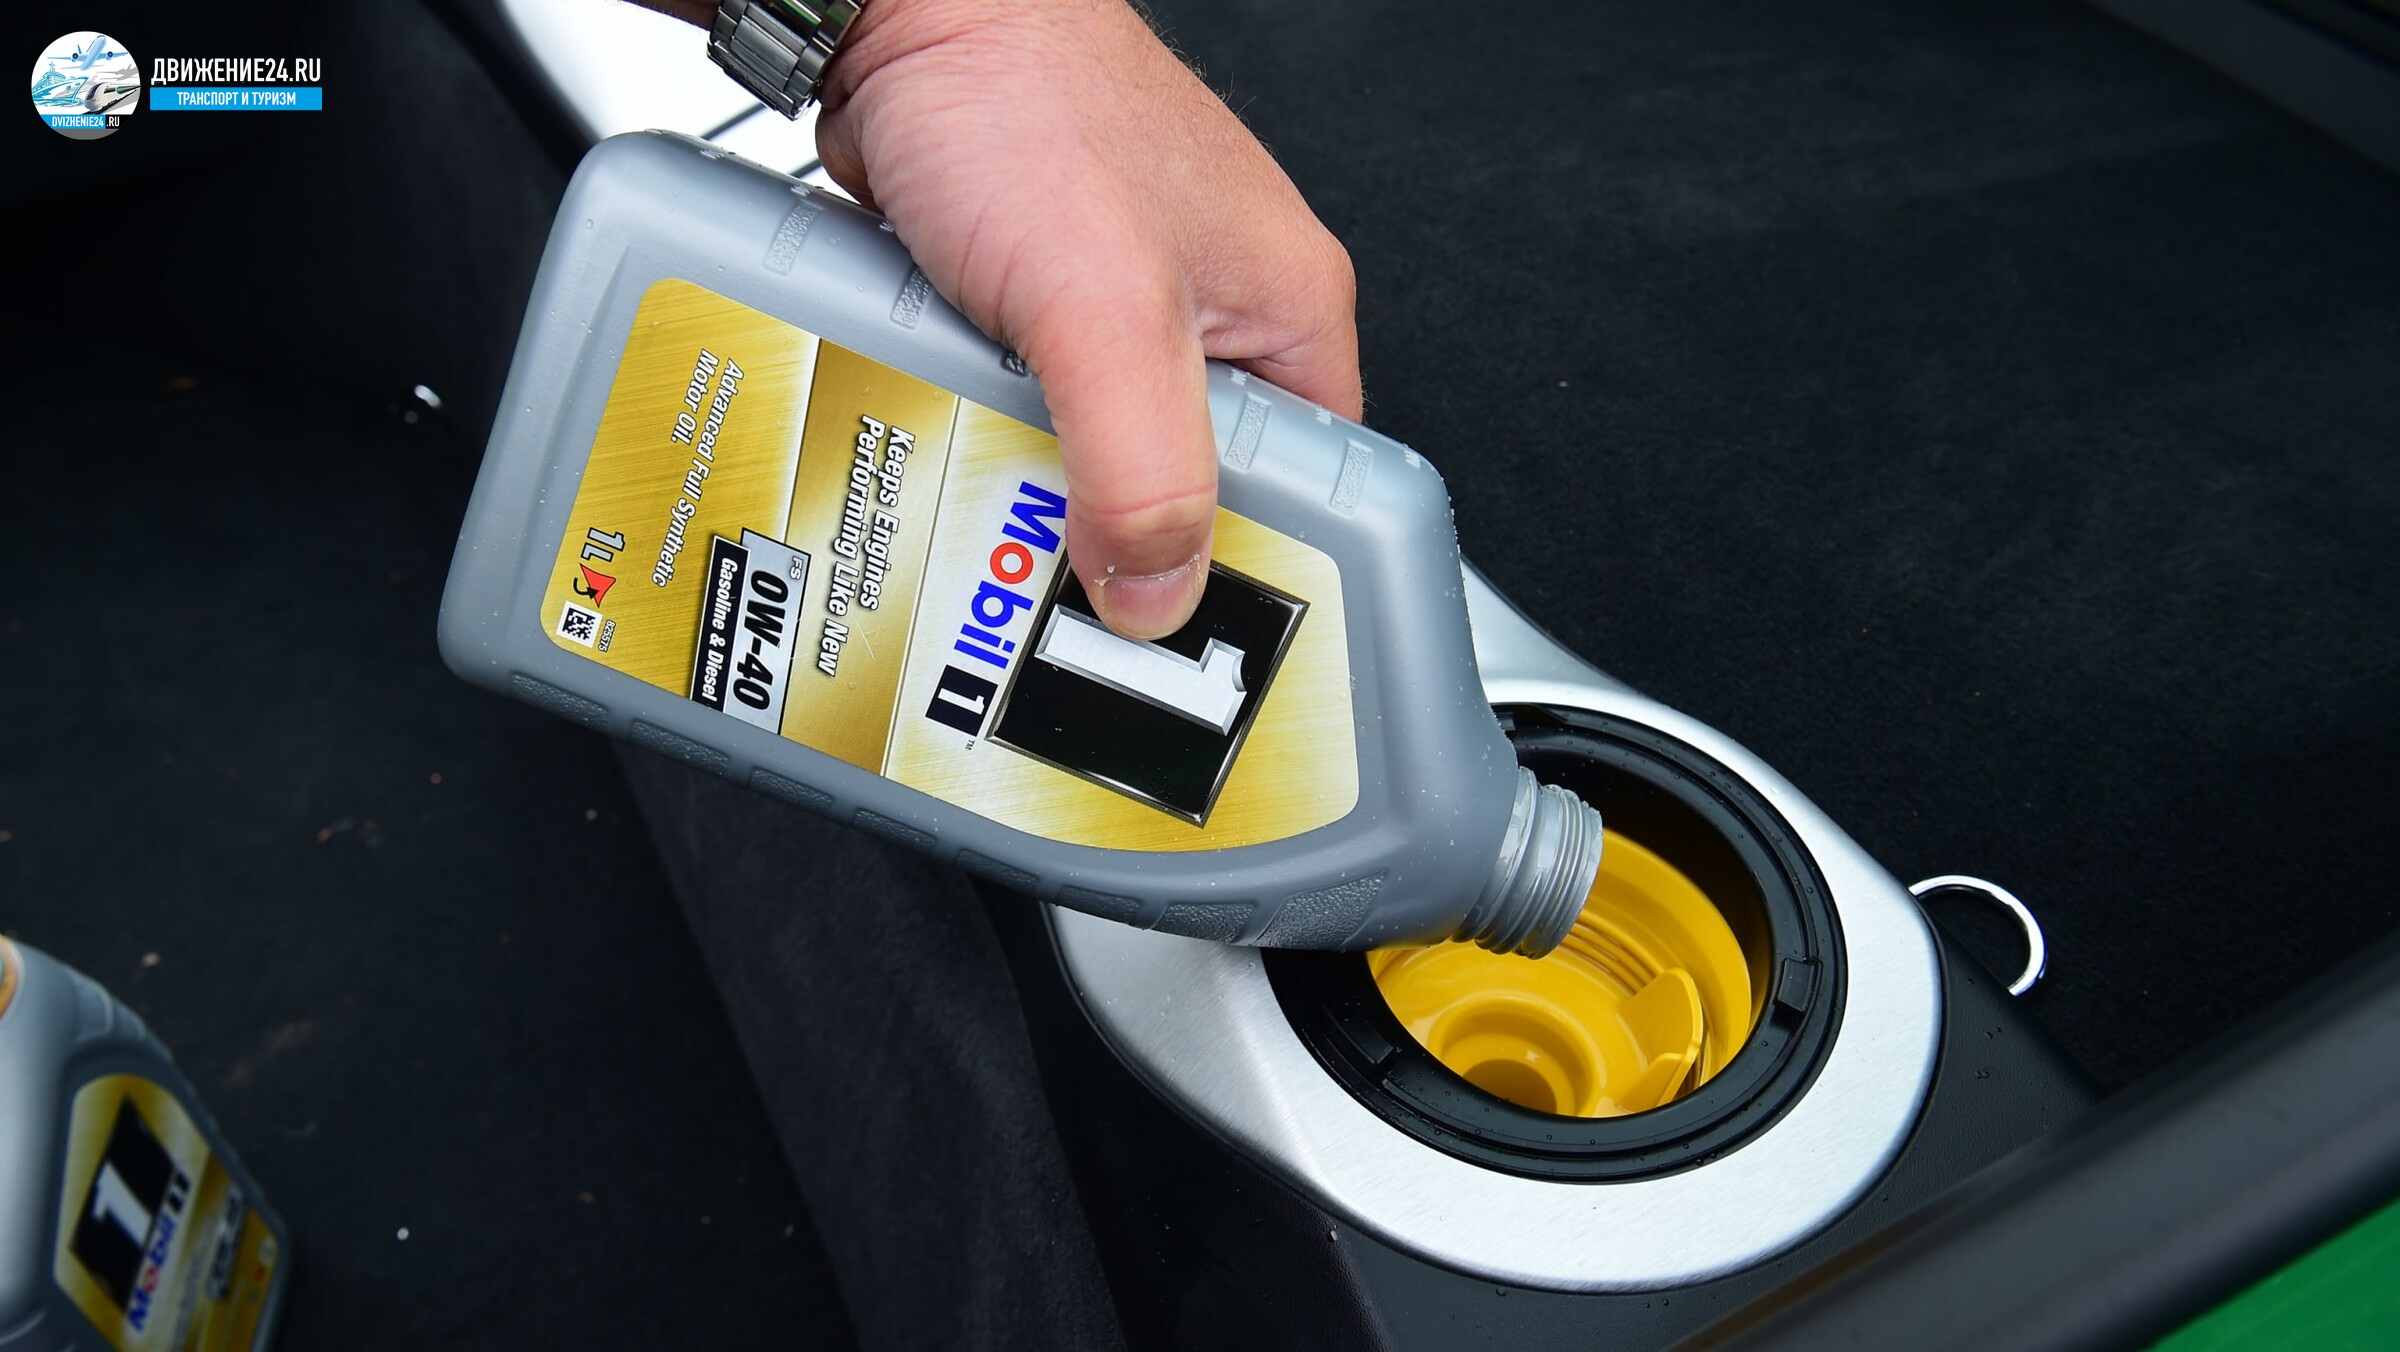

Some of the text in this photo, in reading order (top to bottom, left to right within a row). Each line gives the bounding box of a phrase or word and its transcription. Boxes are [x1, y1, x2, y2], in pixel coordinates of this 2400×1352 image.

[671, 348, 720, 446] Motor Oil.
[652, 357, 744, 587] Advanced Full Synthetic
[859, 425, 916, 611] Keeps Engines
[580, 527, 626, 563] 1L
[790, 555, 804, 582] FS
[817, 414, 887, 678] Performing Like New
[953, 480, 1067, 669] Mobil
[702, 557, 738, 702] Gasoline & Diesel
[733, 570, 789, 711] 0W-40
[1035, 603, 1247, 736] 1
[93, 1160, 152, 1250] 1
